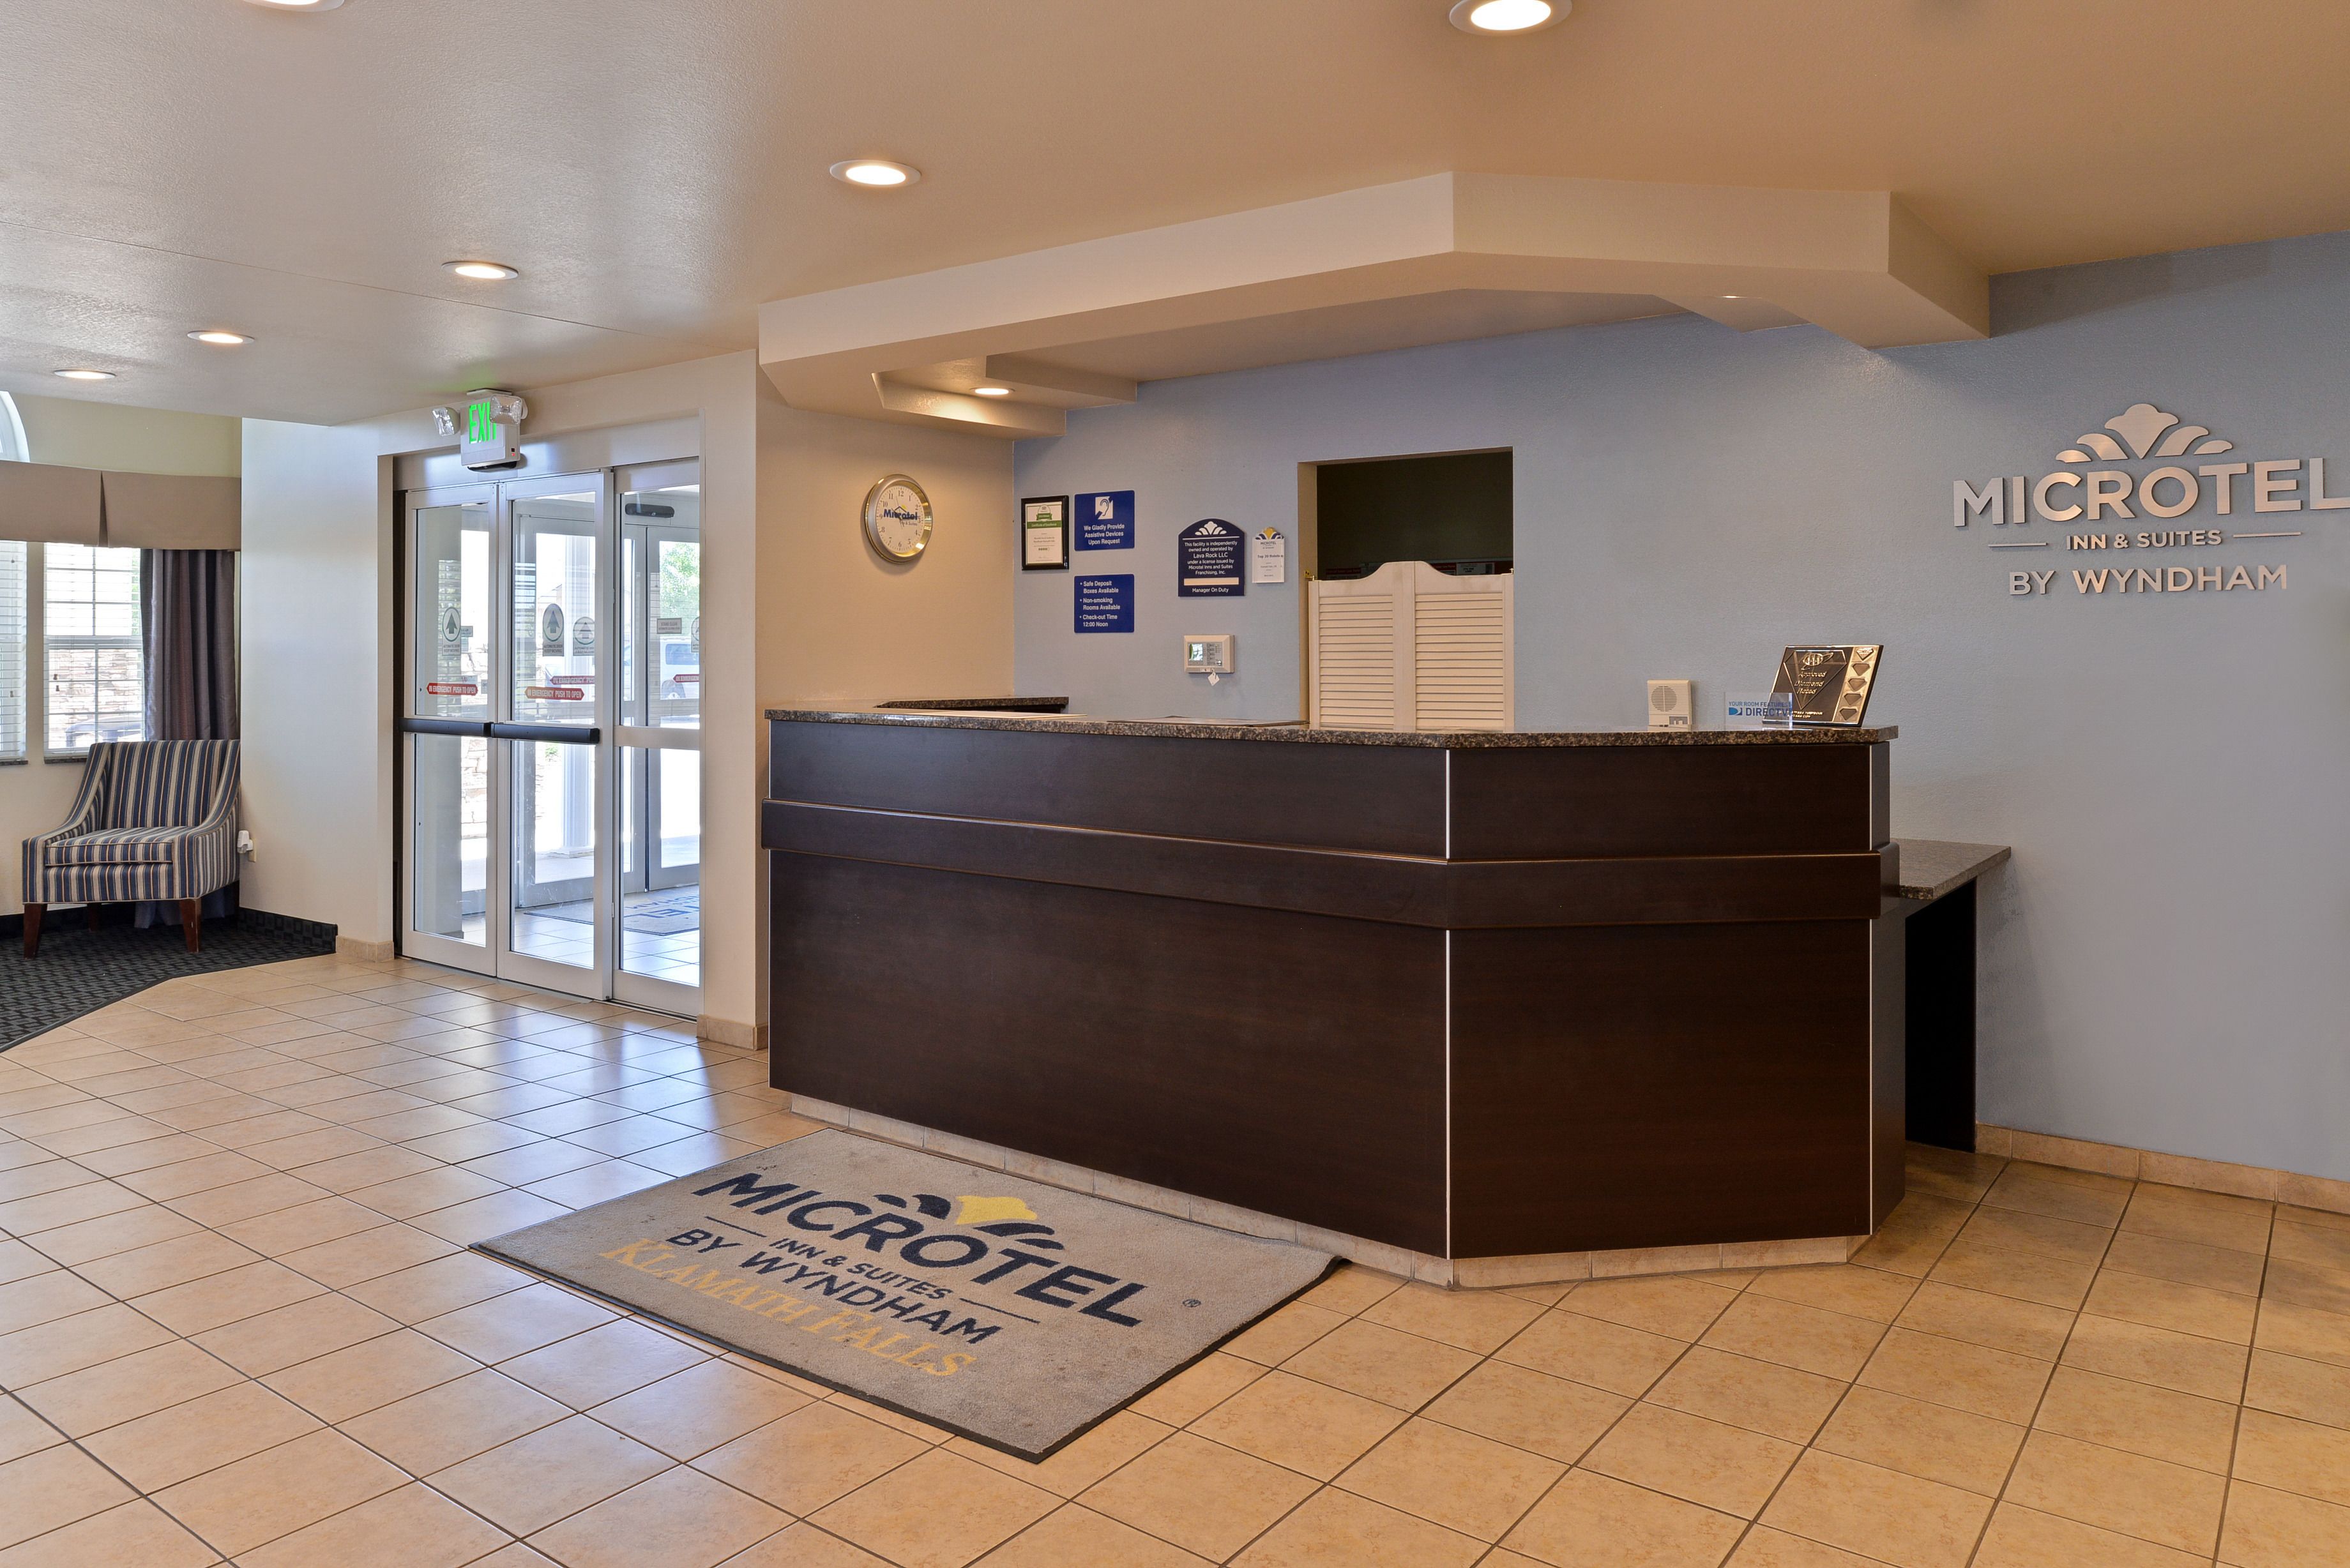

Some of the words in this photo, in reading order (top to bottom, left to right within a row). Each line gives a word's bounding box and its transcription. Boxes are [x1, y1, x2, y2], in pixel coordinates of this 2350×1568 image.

[1953, 457, 2350, 527] MICROTEL
[2066, 534, 2107, 551] INN
[2113, 533, 2130, 550] &
[2136, 529, 2223, 548] SUITES
[2009, 570, 2056, 596] BY
[2072, 564, 2287, 595] WYNDHAM
[1746, 707, 1789, 716] DIRECTV
[691, 1172, 1148, 1327] MICROTEL
[769, 1238, 826, 1260] INN
[822, 1255, 847, 1267] &
[847, 1262, 952, 1301] SUITES
[599, 1237, 822, 1323] KLAMATH
[799, 1307, 978, 1377] FALLS
[666, 1228, 745, 1254] BY
[738, 1251, 1003, 1345] WYNDHAM
